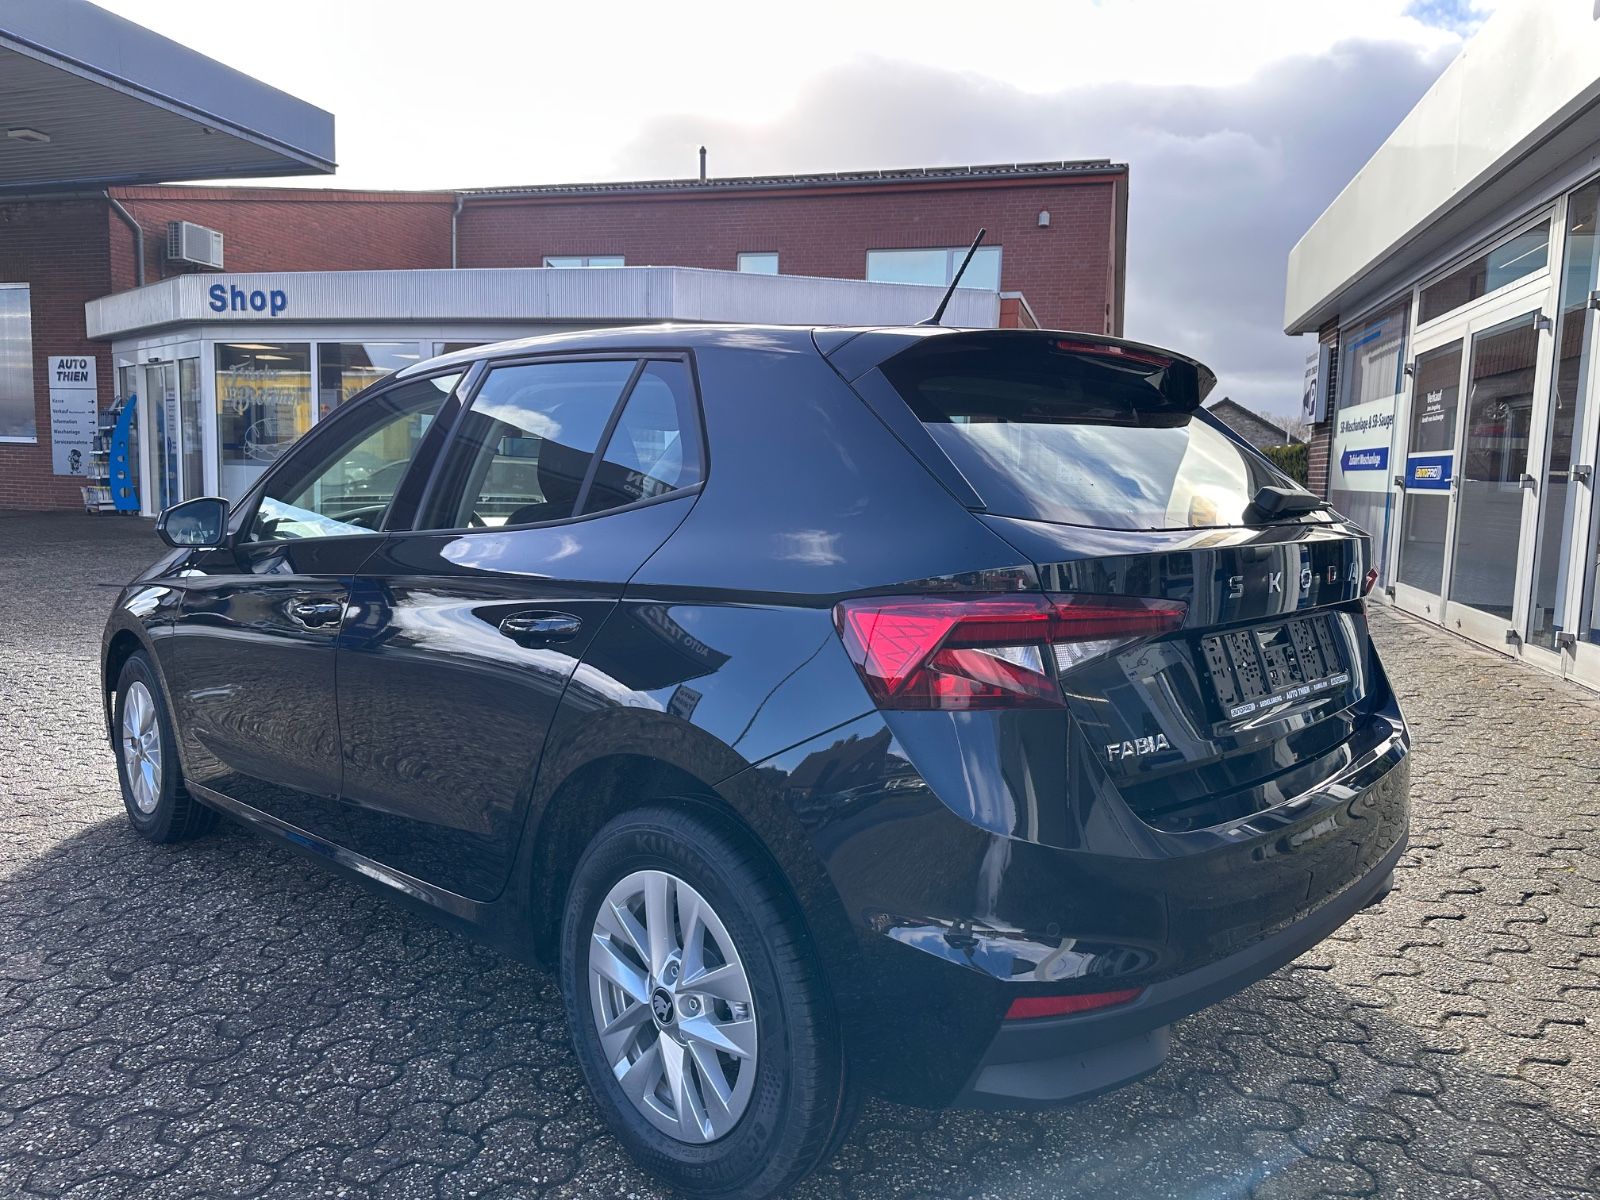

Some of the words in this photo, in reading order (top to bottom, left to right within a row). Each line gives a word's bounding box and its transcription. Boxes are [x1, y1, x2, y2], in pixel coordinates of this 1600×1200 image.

[209, 284, 287, 316] Shop
[57, 359, 87, 370] AUTO
[56, 371, 88, 382] THIEN
[1286, 689, 1298, 700] AUTO
[1298, 685, 1311, 697] THIEN
[1106, 733, 1170, 762] FABIA
